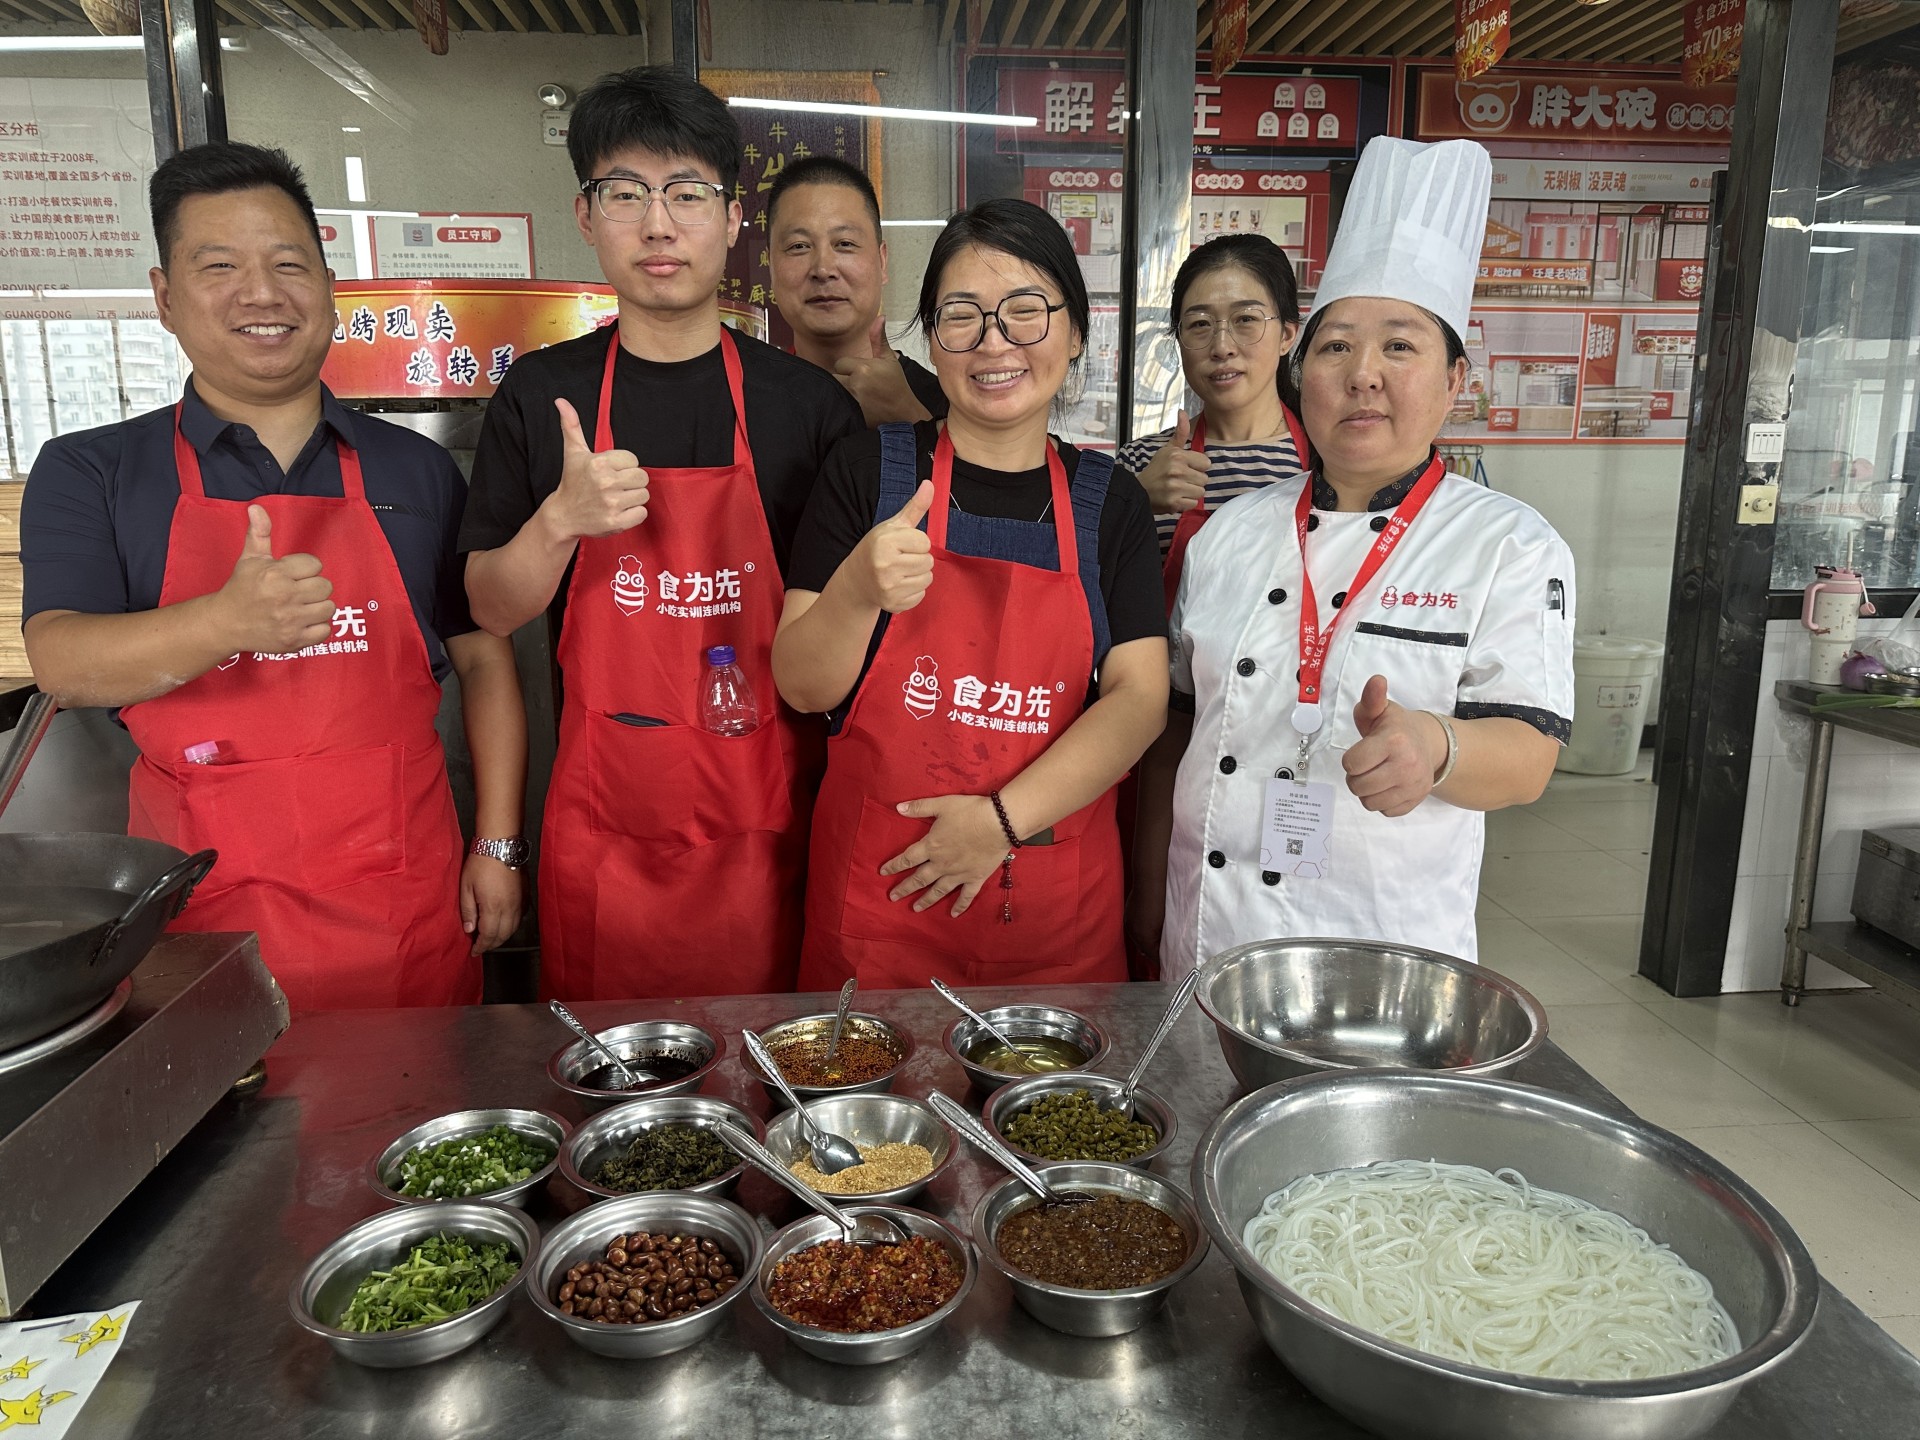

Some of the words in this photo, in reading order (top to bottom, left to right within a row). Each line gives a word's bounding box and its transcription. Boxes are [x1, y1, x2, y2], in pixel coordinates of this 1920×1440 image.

[1529, 85, 1657, 129] 胖大碗
[769, 121, 788, 143] 牛
[744, 143, 762, 165] 牛
[1197, 176, 1242, 187] 匠心传承
[1543, 170, 1582, 191] 无剁椒
[1588, 171, 1627, 192] 没灵魂
[447, 229, 492, 241] 员工守则
[5, 310, 72, 320] GUANGDONG
[97, 309, 117, 320] 江西
[657, 568, 741, 603] 食为先
[656, 600, 741, 619] 小吃实训连锁机构
[1402, 591, 1458, 609] 食为先
[953, 674, 1051, 718] 食为先
[947, 708, 1049, 734] 小吃实训连锁机构
